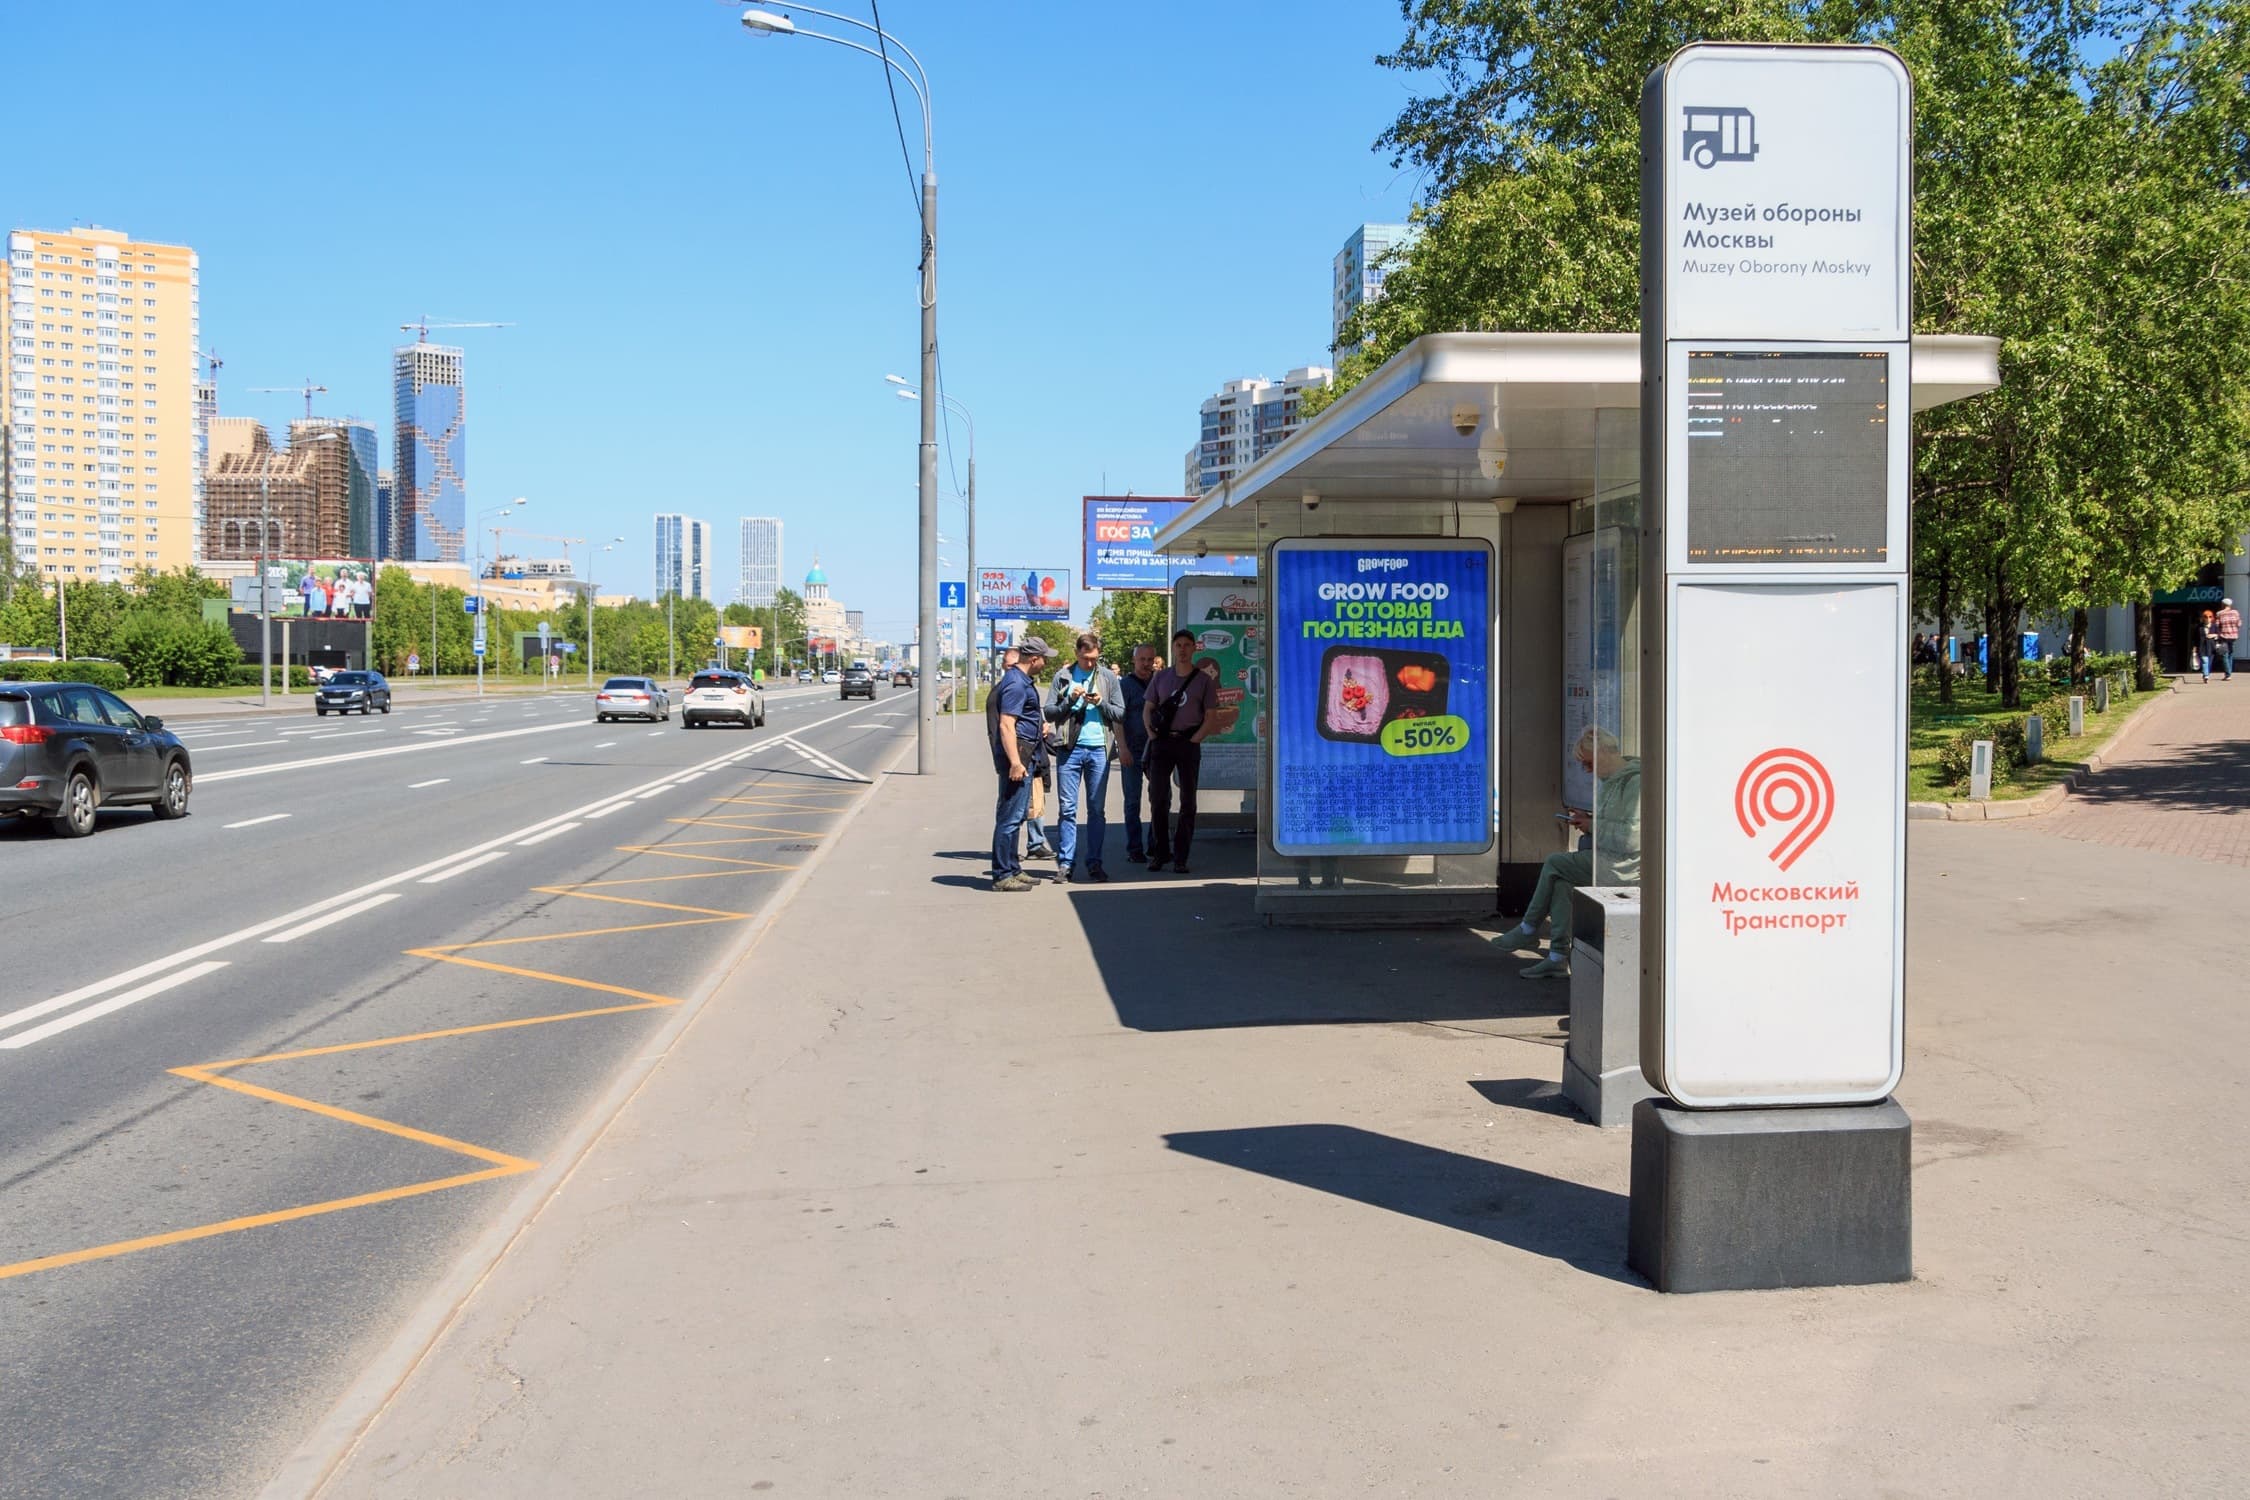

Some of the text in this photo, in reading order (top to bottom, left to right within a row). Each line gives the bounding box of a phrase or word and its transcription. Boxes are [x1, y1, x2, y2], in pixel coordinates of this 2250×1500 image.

[1683, 202, 1861, 226] Музей обороны
[1683, 229, 1774, 249] Москвы
[1682, 259, 1871, 277] Muzey Oborony Moskvy
[1100, 526, 1129, 538] ГОС
[1358, 558, 1408, 573] GROWFOOD
[982, 581, 1011, 591] НАМ
[1318, 583, 1449, 600] GROW FOOD
[982, 595, 1027, 606] ВЫШЕ!
[1336, 602, 1432, 619] ГОТОВАЯ
[1303, 621, 1465, 639] ПОЛЕЗНАЯ ЕДА
[1394, 726, 1455, 748] -50%
[1711, 881, 1860, 903] Московский
[1722, 909, 1847, 937] Транспорт
